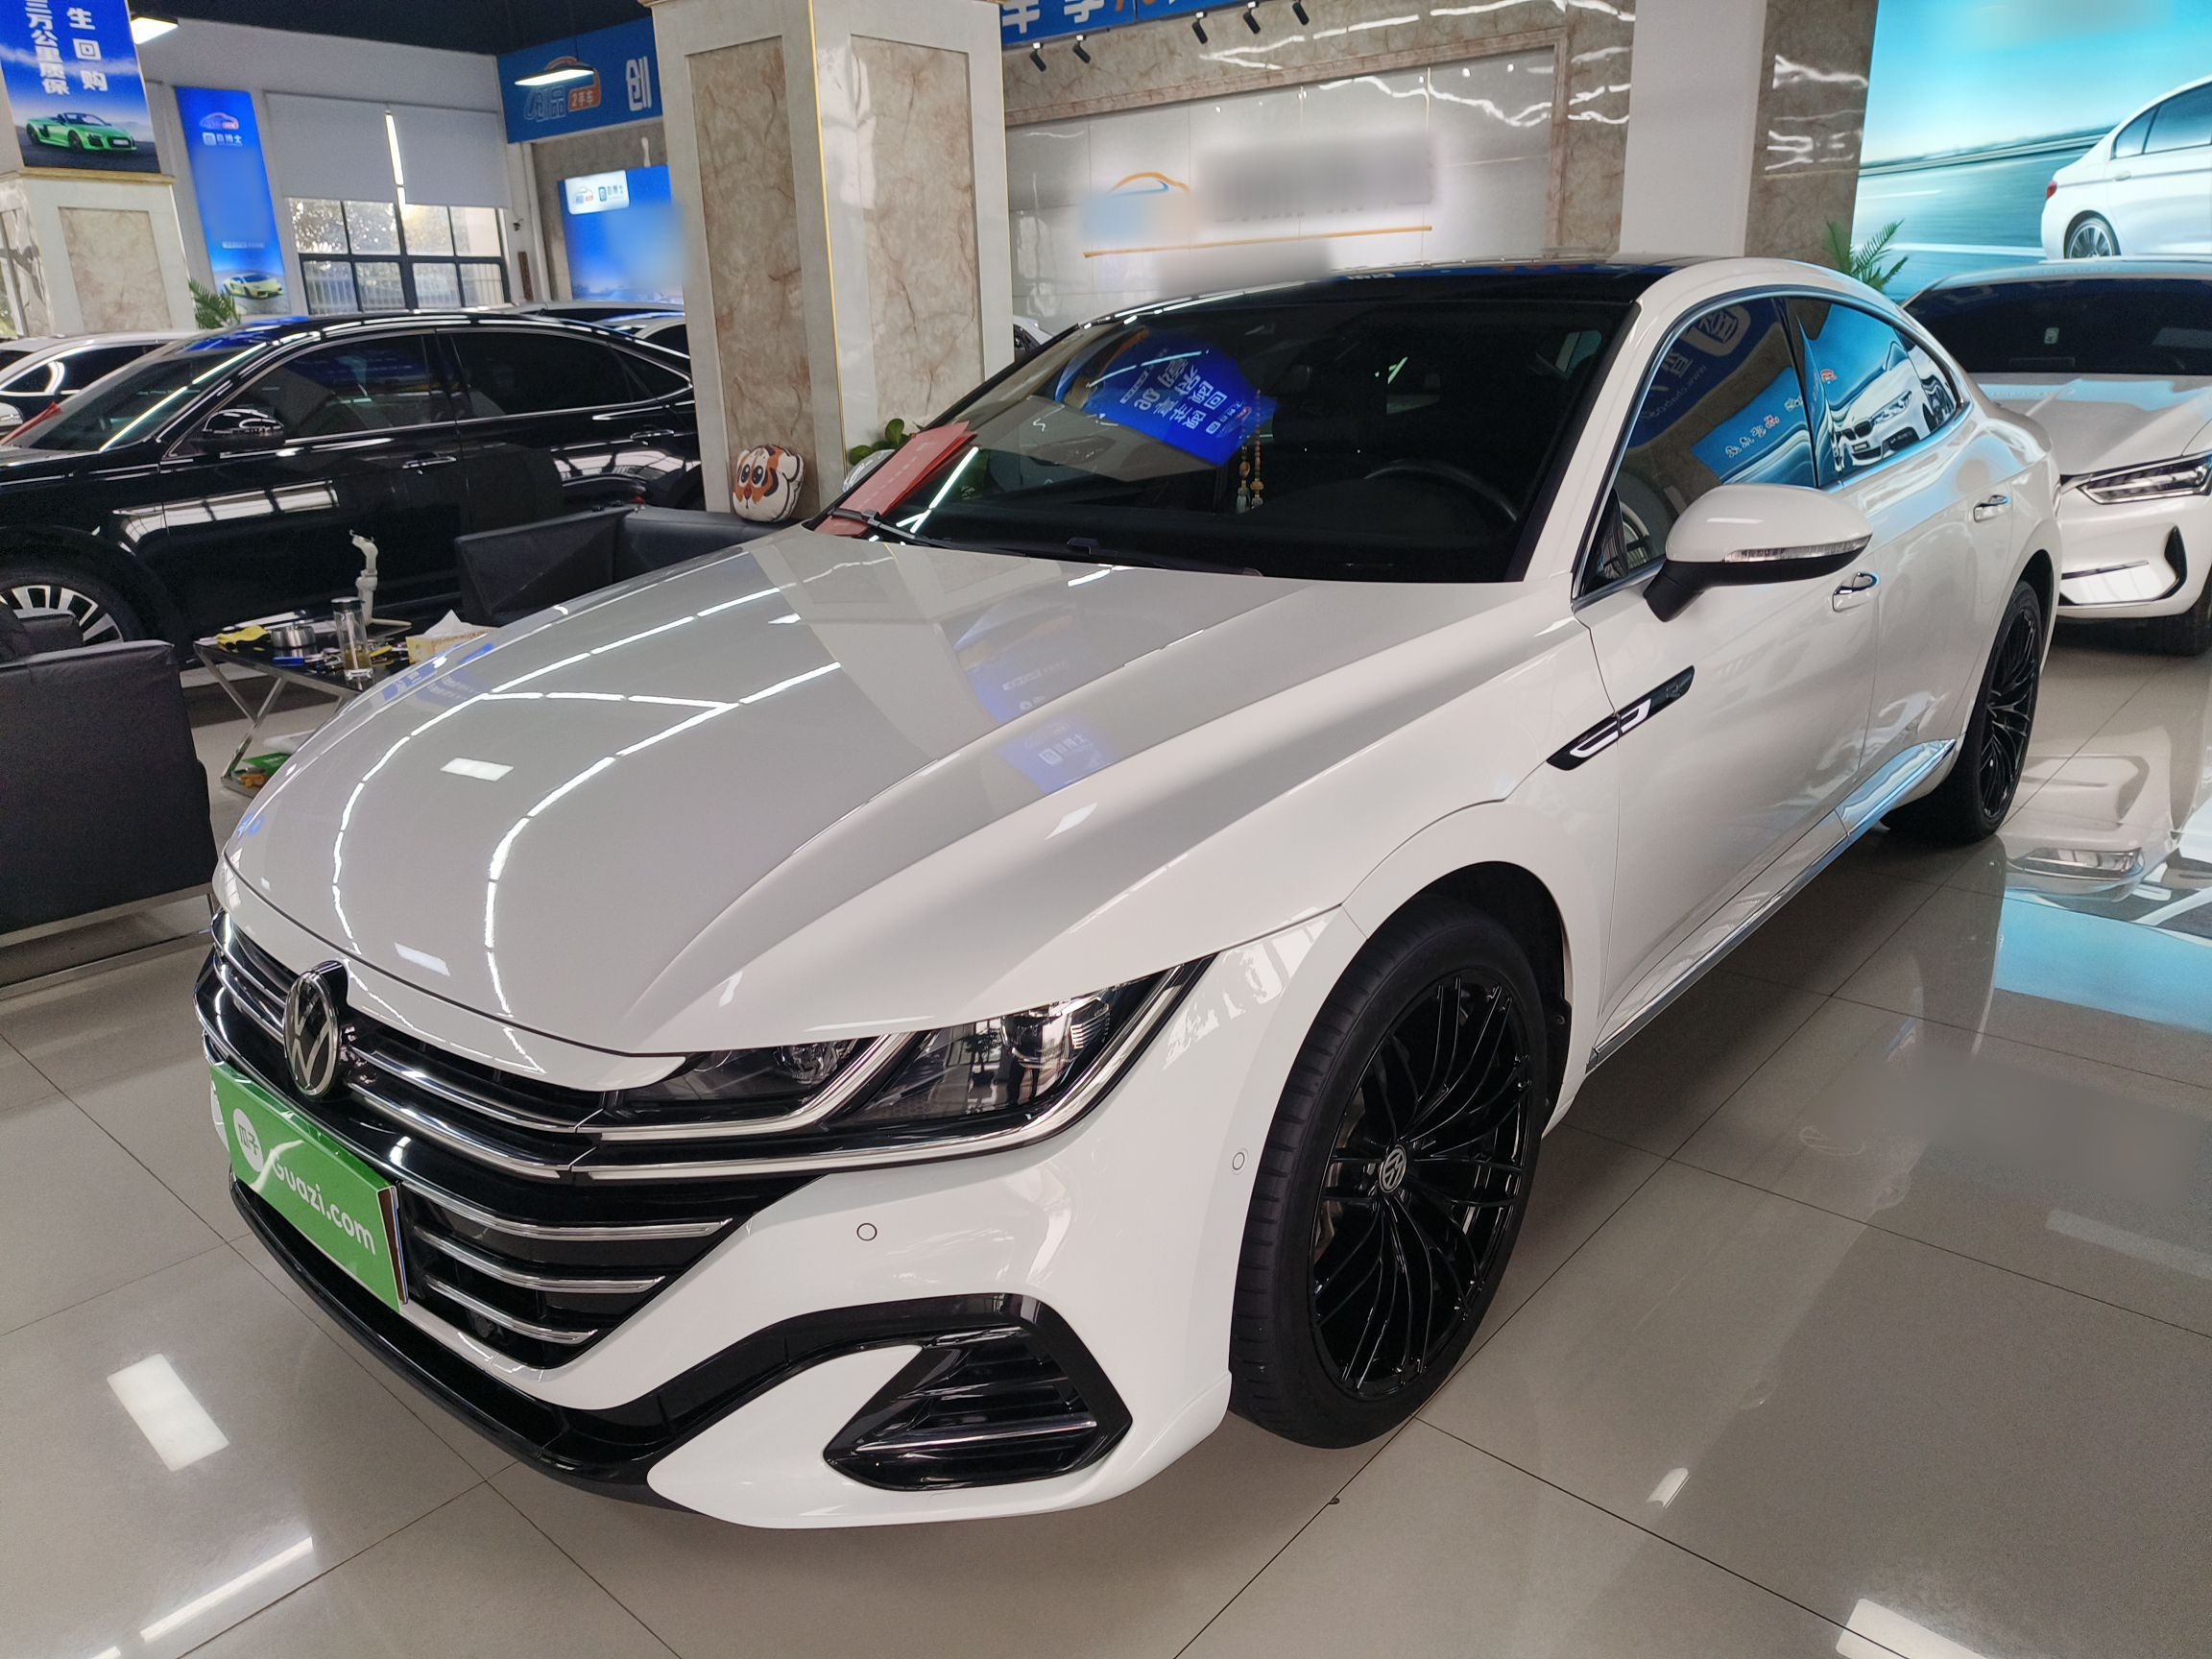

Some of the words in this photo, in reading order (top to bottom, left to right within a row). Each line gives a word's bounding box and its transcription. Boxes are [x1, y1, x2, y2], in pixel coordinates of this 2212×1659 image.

[67, 7, 108, 92] 生回购
[273, 1155, 376, 1255] Guazi.com
